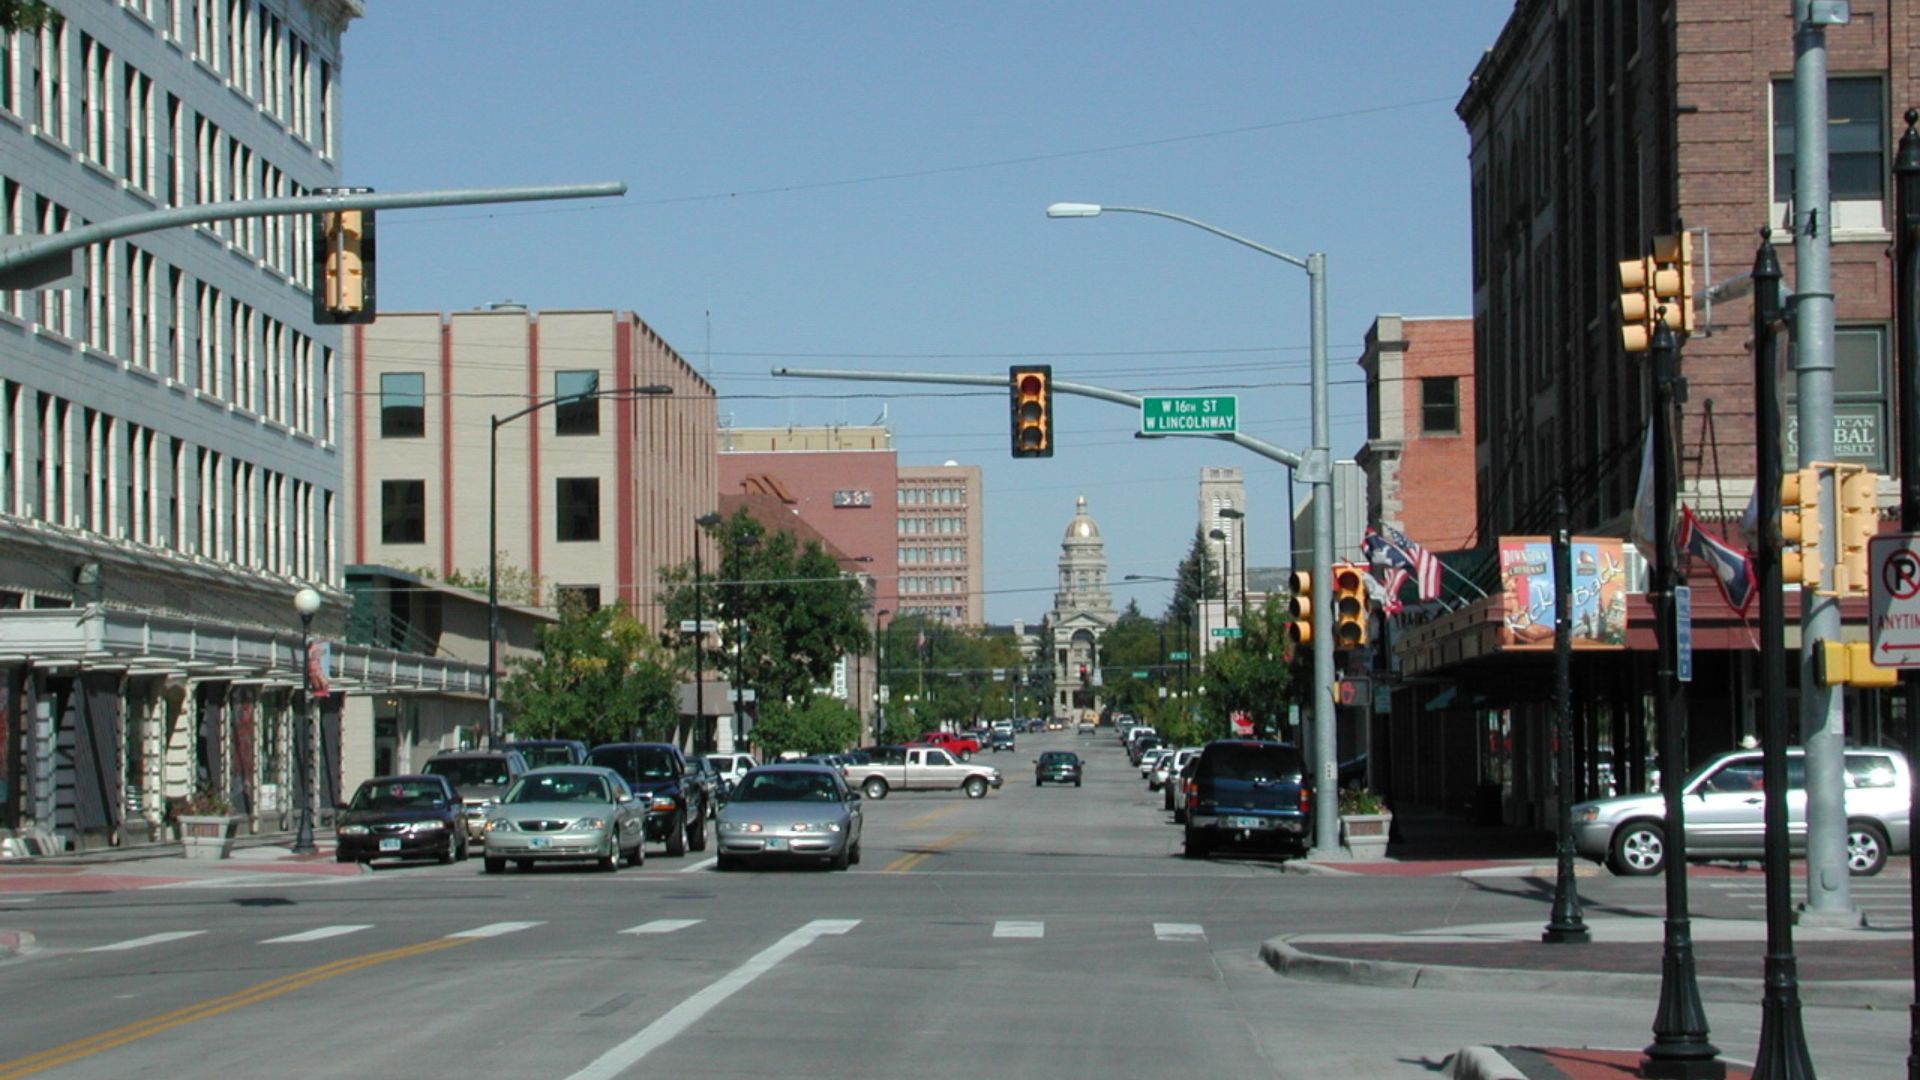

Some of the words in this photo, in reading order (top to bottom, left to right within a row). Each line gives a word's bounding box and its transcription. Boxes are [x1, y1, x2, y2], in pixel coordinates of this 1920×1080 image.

[1161, 400, 1172, 412] W
[1203, 400, 1217, 412] ST
[1146, 417, 1155, 429] W
[1159, 416, 1233, 429] LINCOLNWAY
